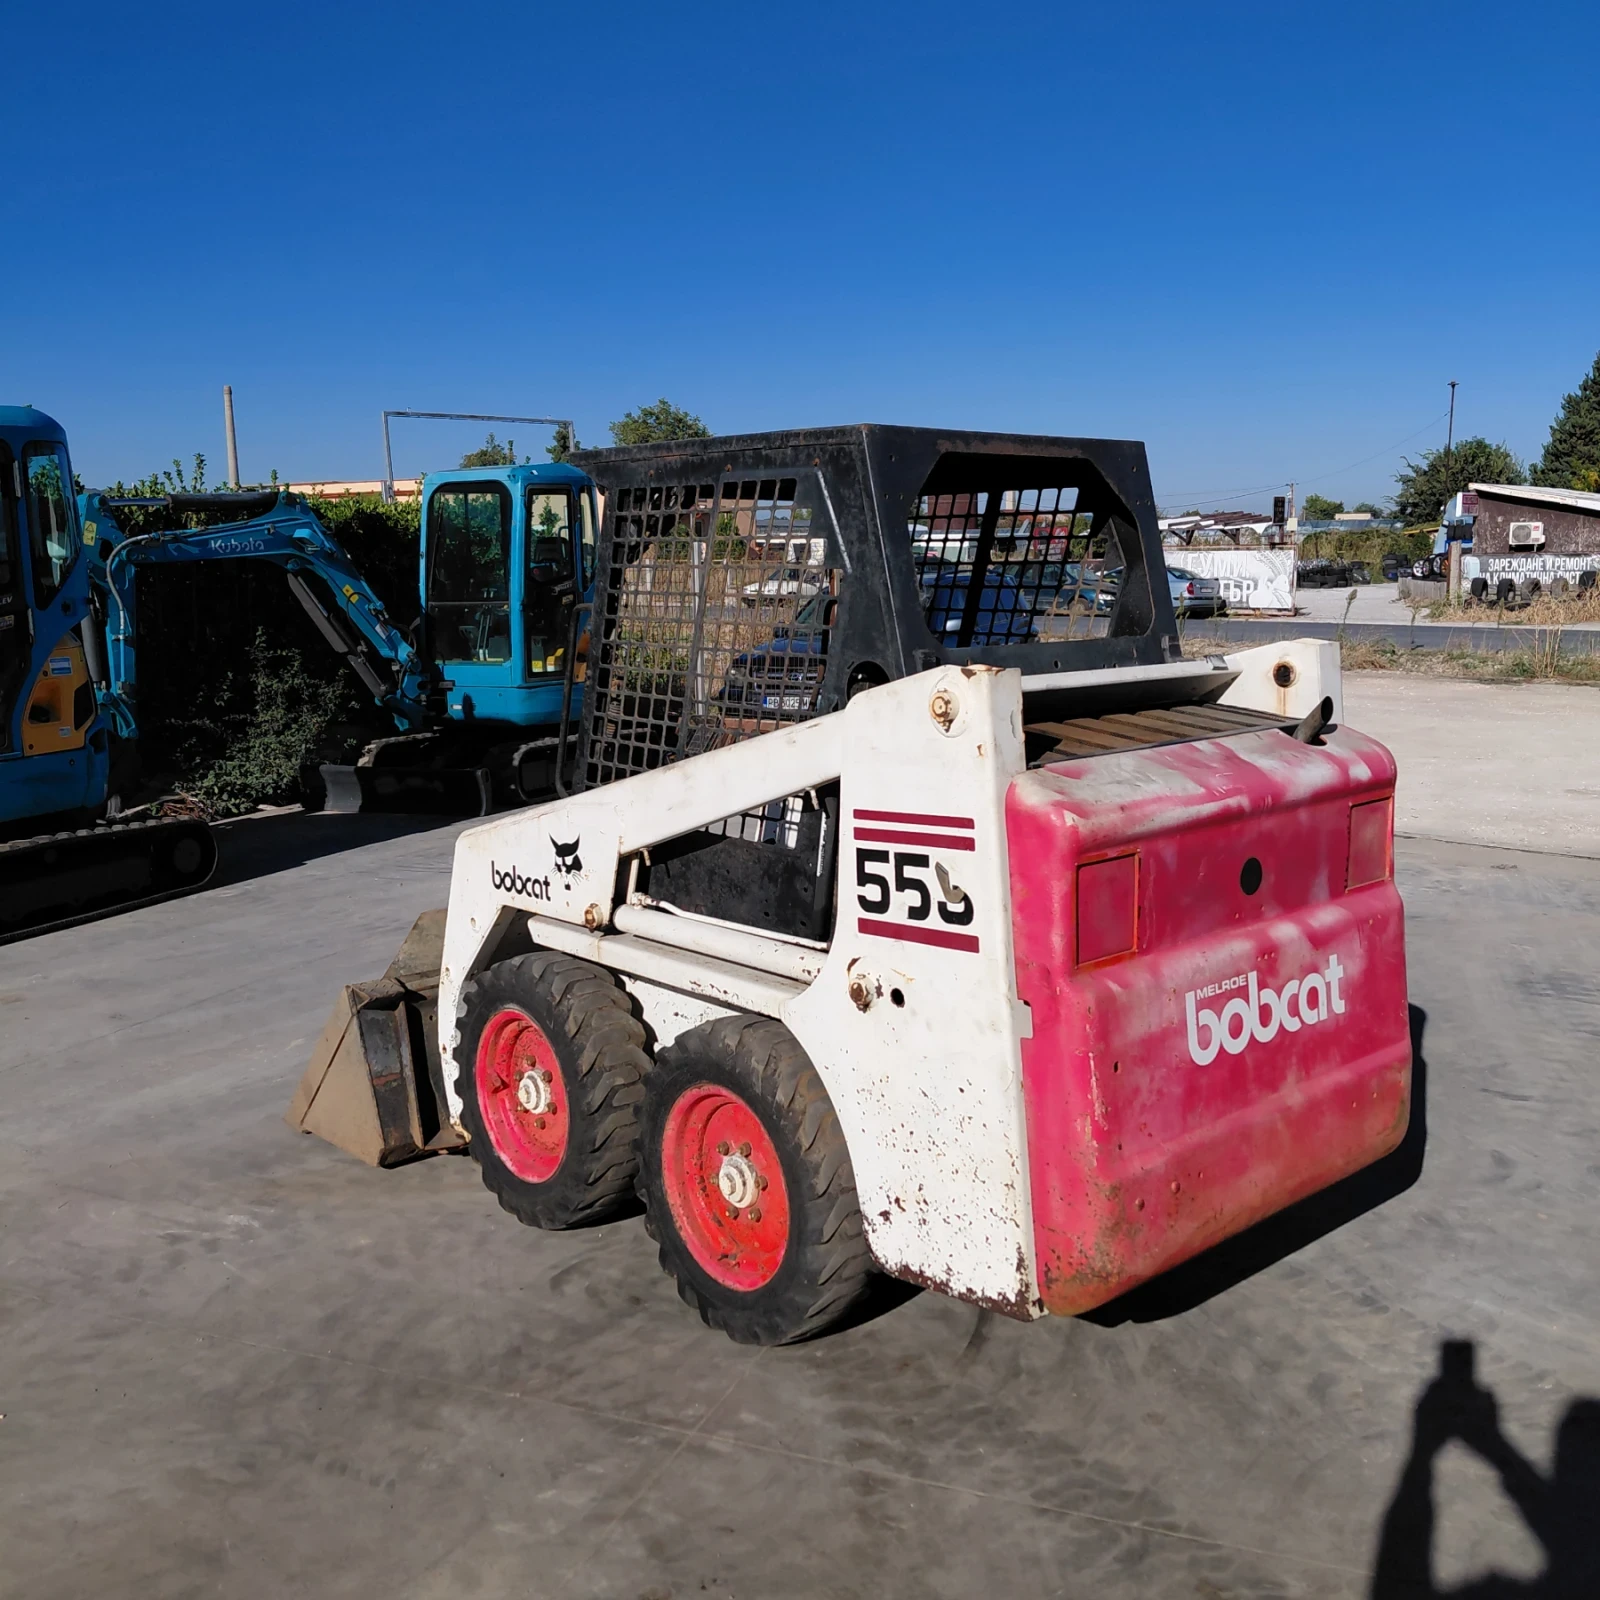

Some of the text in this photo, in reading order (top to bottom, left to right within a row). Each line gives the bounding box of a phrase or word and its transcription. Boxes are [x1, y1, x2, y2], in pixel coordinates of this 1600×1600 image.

[211, 537, 264, 553] Kubota
[1488, 557, 1592, 572] ЗАРЕЖДАНЕ И РЕМОНТ
[1557, 572, 1580, 585] СИСТ
[1219, 580, 1254, 602] ТЪР
[491, 860, 551, 902] bobcat
[1196, 974, 1247, 1000] MELROE
[1185, 953, 1345, 1066] bobcat
